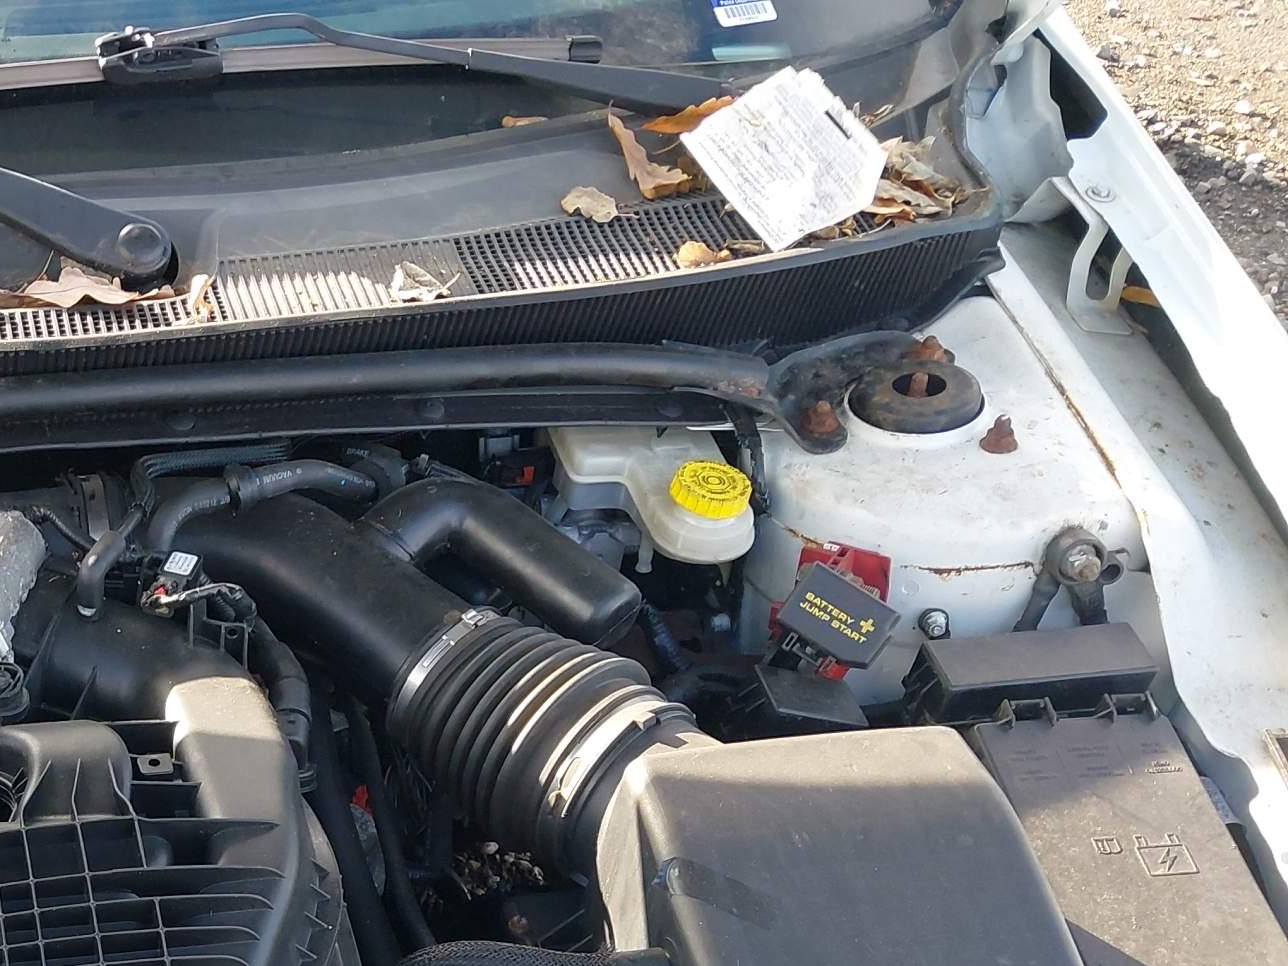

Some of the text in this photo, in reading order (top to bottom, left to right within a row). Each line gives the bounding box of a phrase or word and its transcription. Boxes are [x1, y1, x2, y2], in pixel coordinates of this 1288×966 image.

[800, 601, 867, 644] JUMP START
[805, 592, 855, 625] BATTERY
